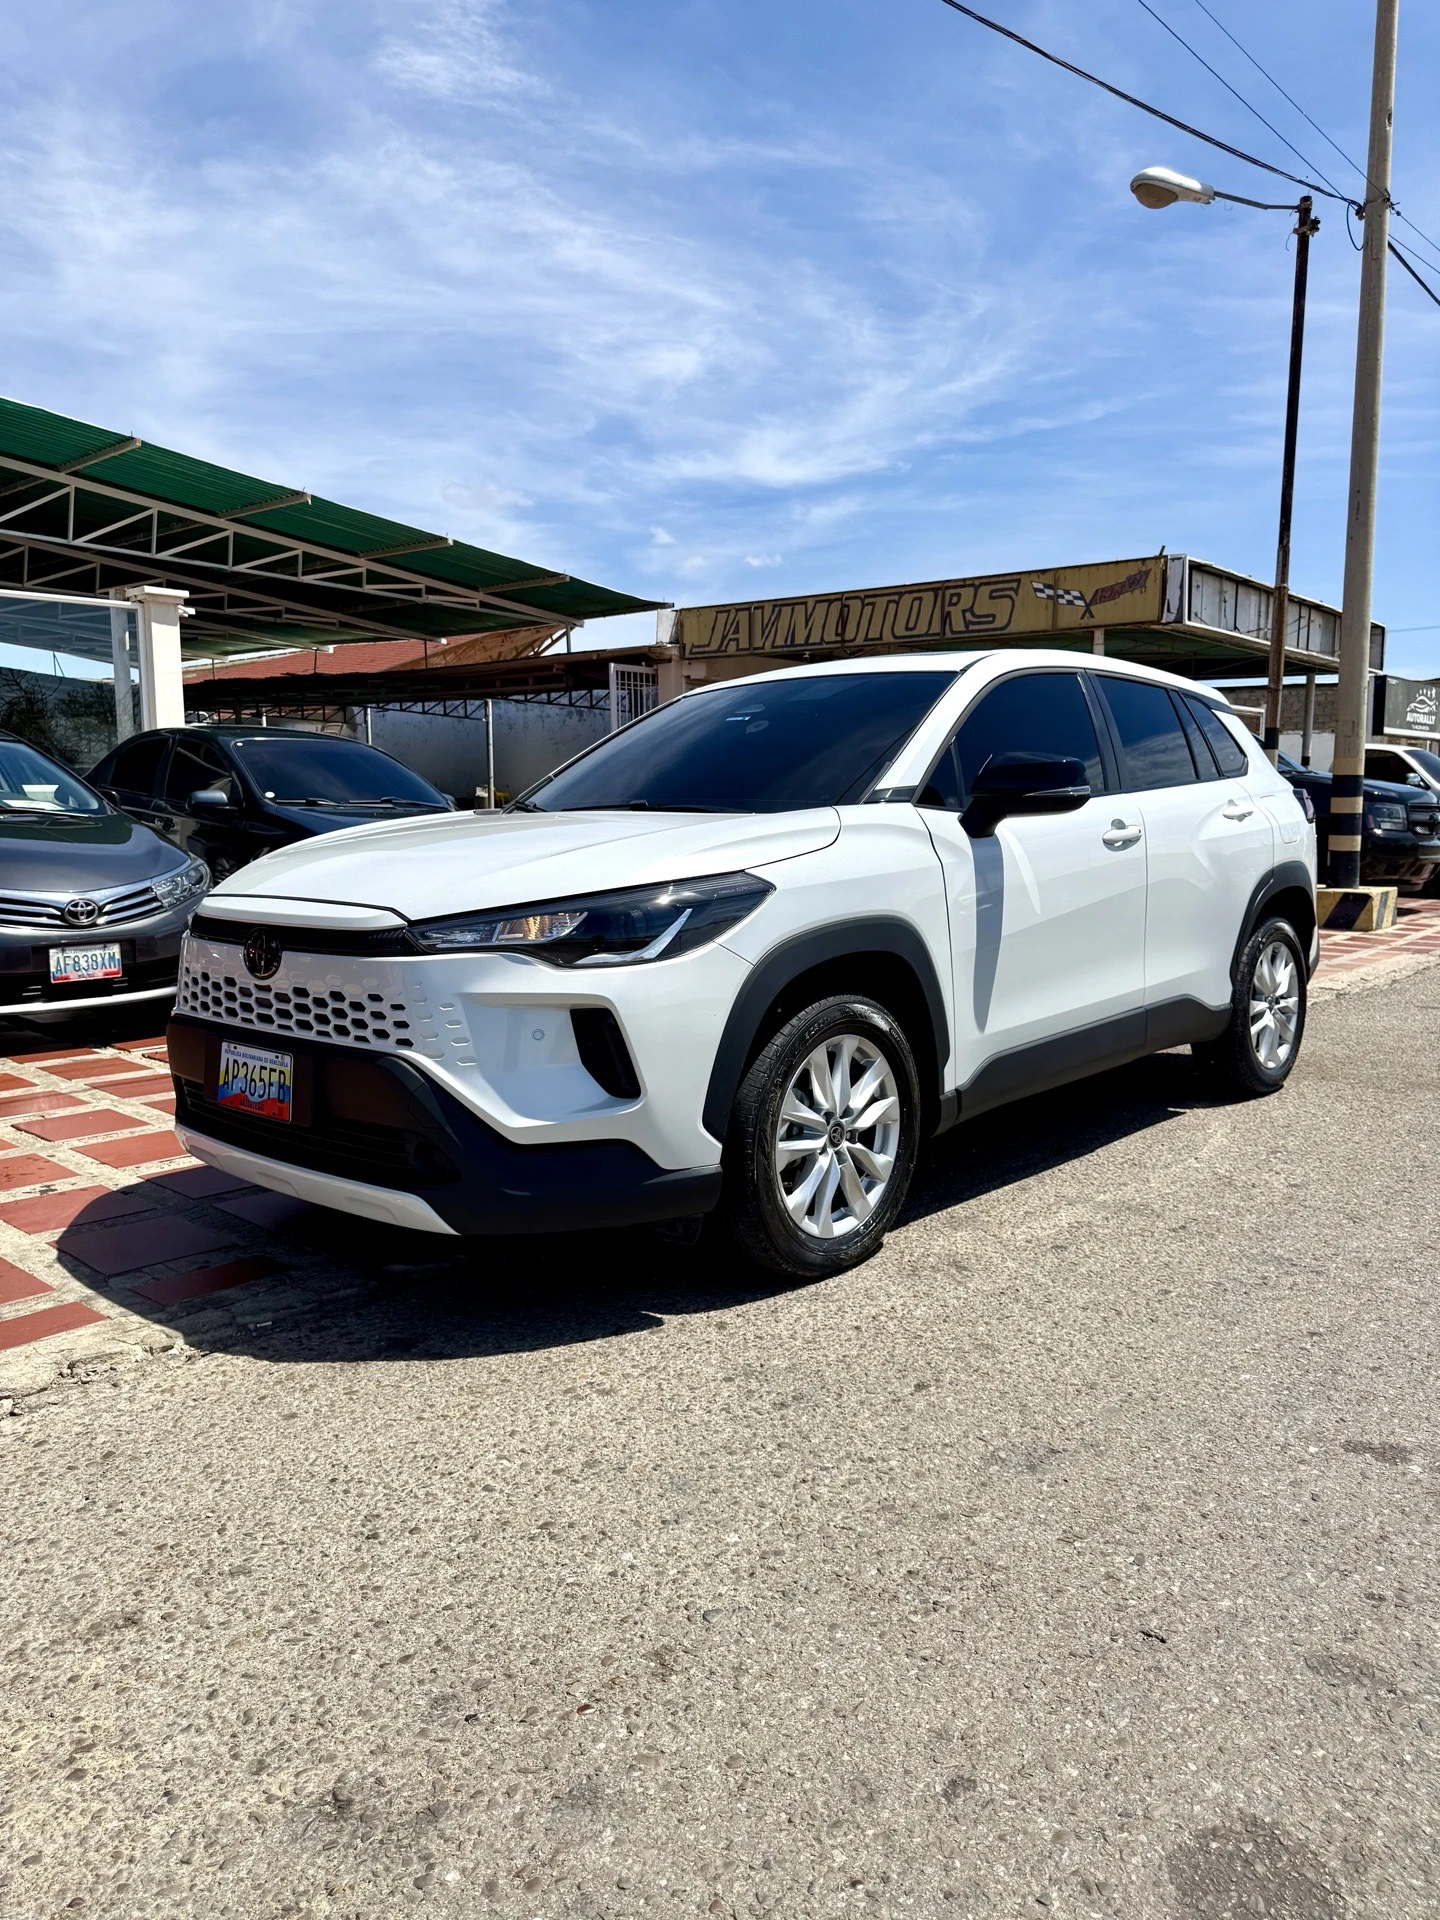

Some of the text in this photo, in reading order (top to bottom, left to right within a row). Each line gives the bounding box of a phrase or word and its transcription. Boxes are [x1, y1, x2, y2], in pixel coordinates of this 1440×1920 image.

[689, 579, 1021, 655] JAVIMOTORS
[1406, 711, 1436, 724] AUTORALLY
[55, 952, 116, 974] AF838XM
[222, 1057, 287, 1104] AP365FB
